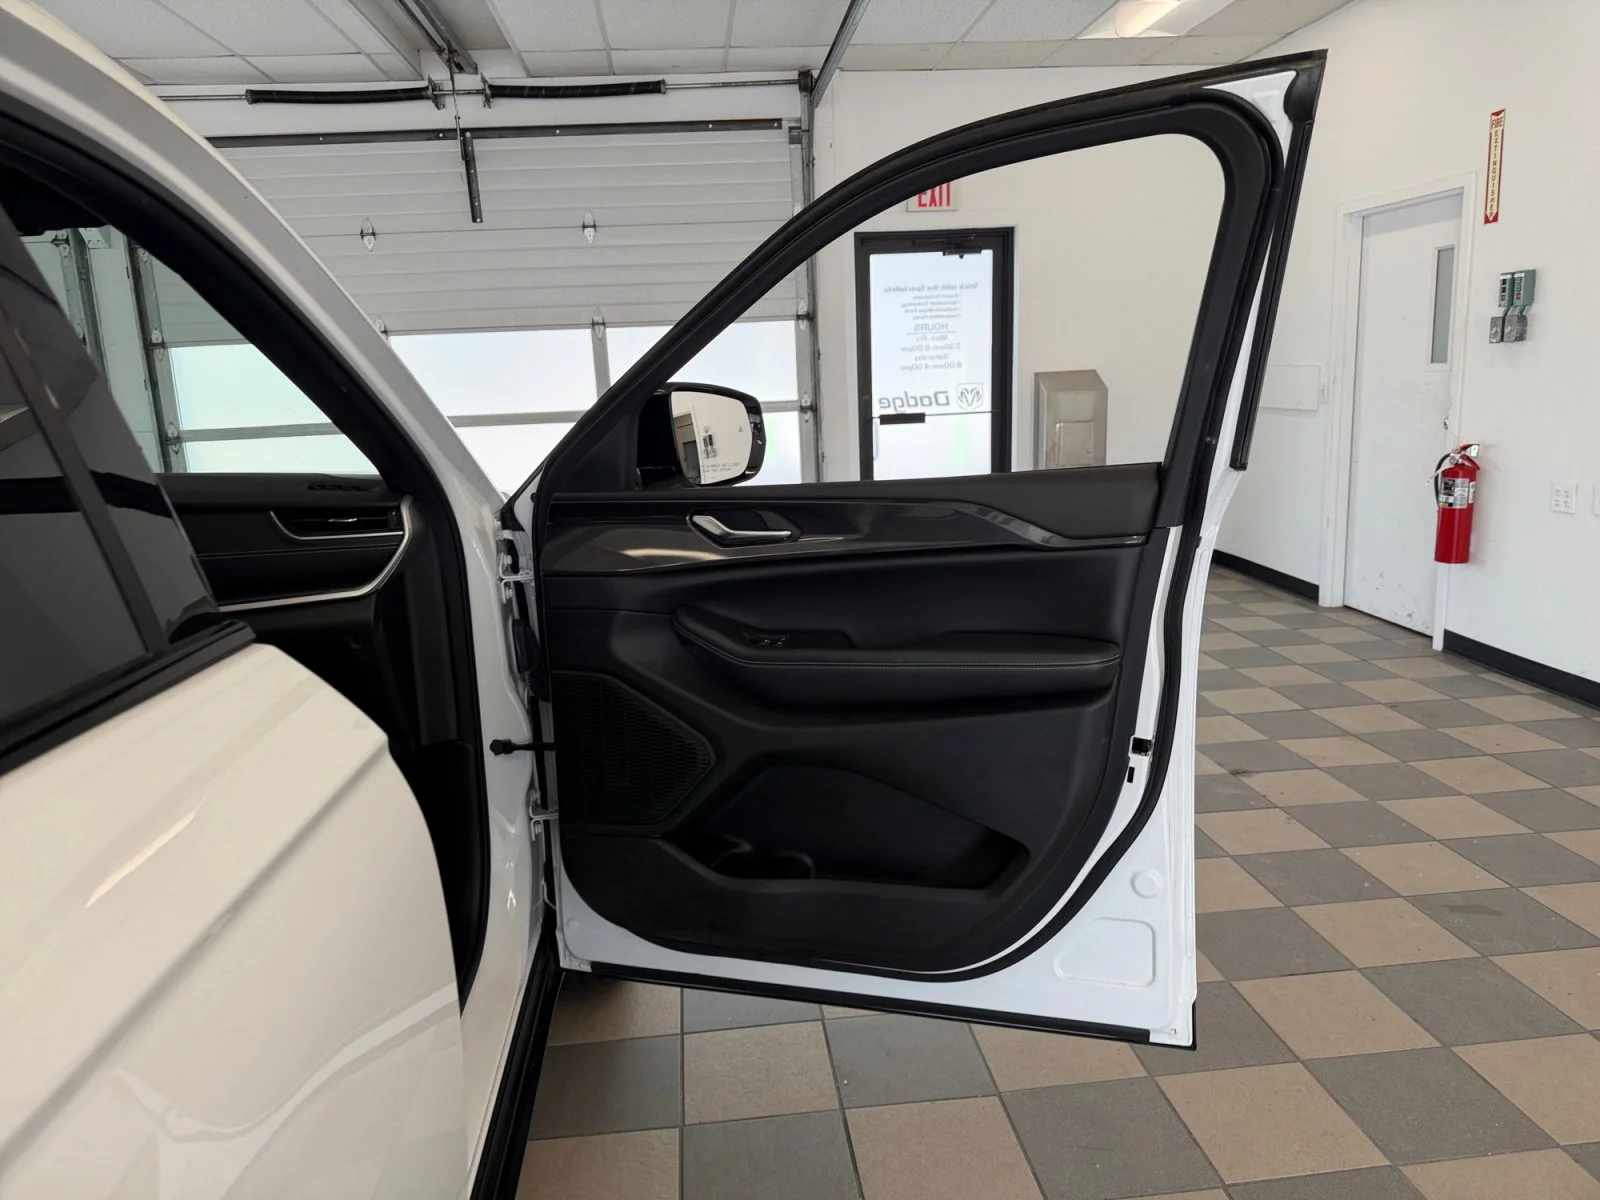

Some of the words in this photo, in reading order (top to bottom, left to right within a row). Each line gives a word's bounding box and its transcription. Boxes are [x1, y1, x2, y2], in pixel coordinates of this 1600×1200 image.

[1491, 117, 1503, 128] FIRE
[1489, 130, 1500, 217] EXTINGUISHER
[918, 182, 951, 208] EXIT
